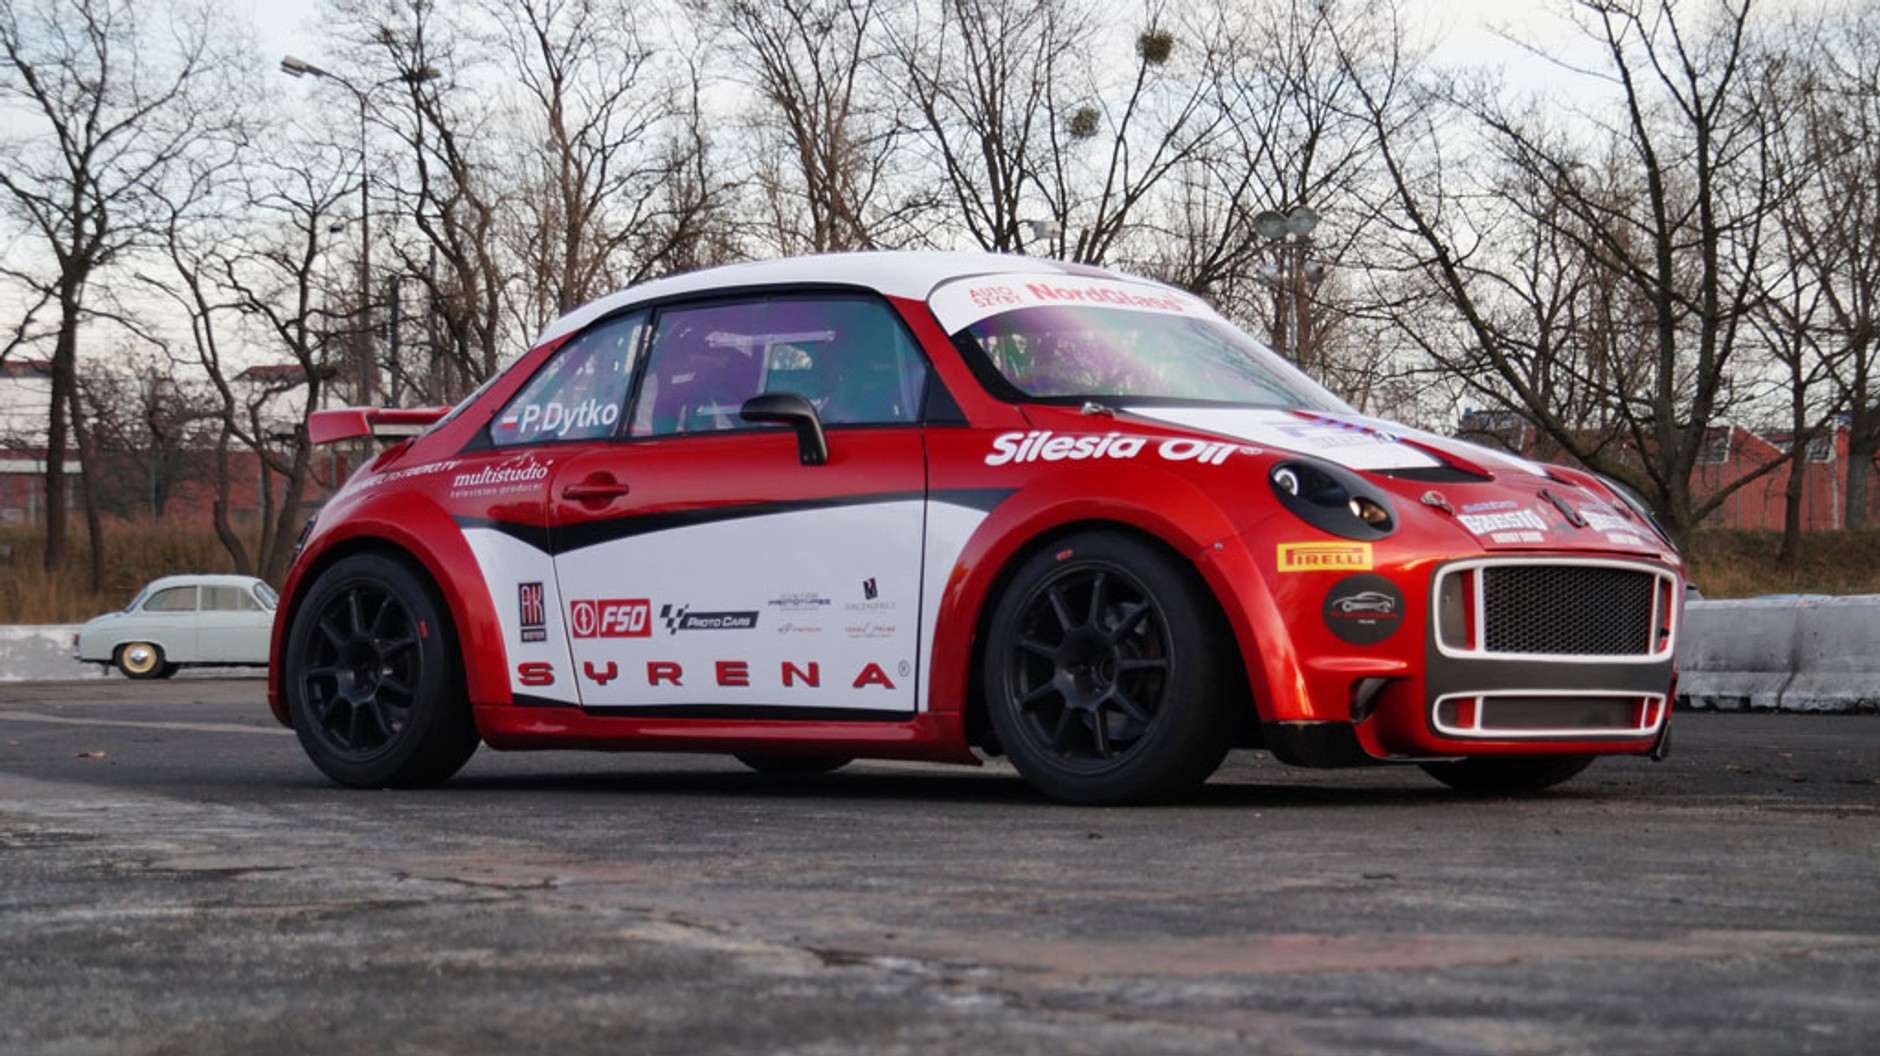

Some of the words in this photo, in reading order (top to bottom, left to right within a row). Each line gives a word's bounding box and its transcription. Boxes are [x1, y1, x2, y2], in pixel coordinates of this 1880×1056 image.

[969, 285, 1013, 299] AUTO
[1025, 283, 1183, 312] NordGlass
[519, 399, 619, 435] P.Dytko
[985, 431, 1147, 466] Silesia
[1158, 438, 1239, 465] Oil
[453, 463, 549, 487] multistudio
[450, 488, 497, 499] television
[500, 483, 544, 495] producer
[1284, 547, 1364, 567] PIRELLI
[521, 585, 543, 624] AK
[601, 606, 648, 633] FSO
[517, 661, 897, 690] SYRENA
